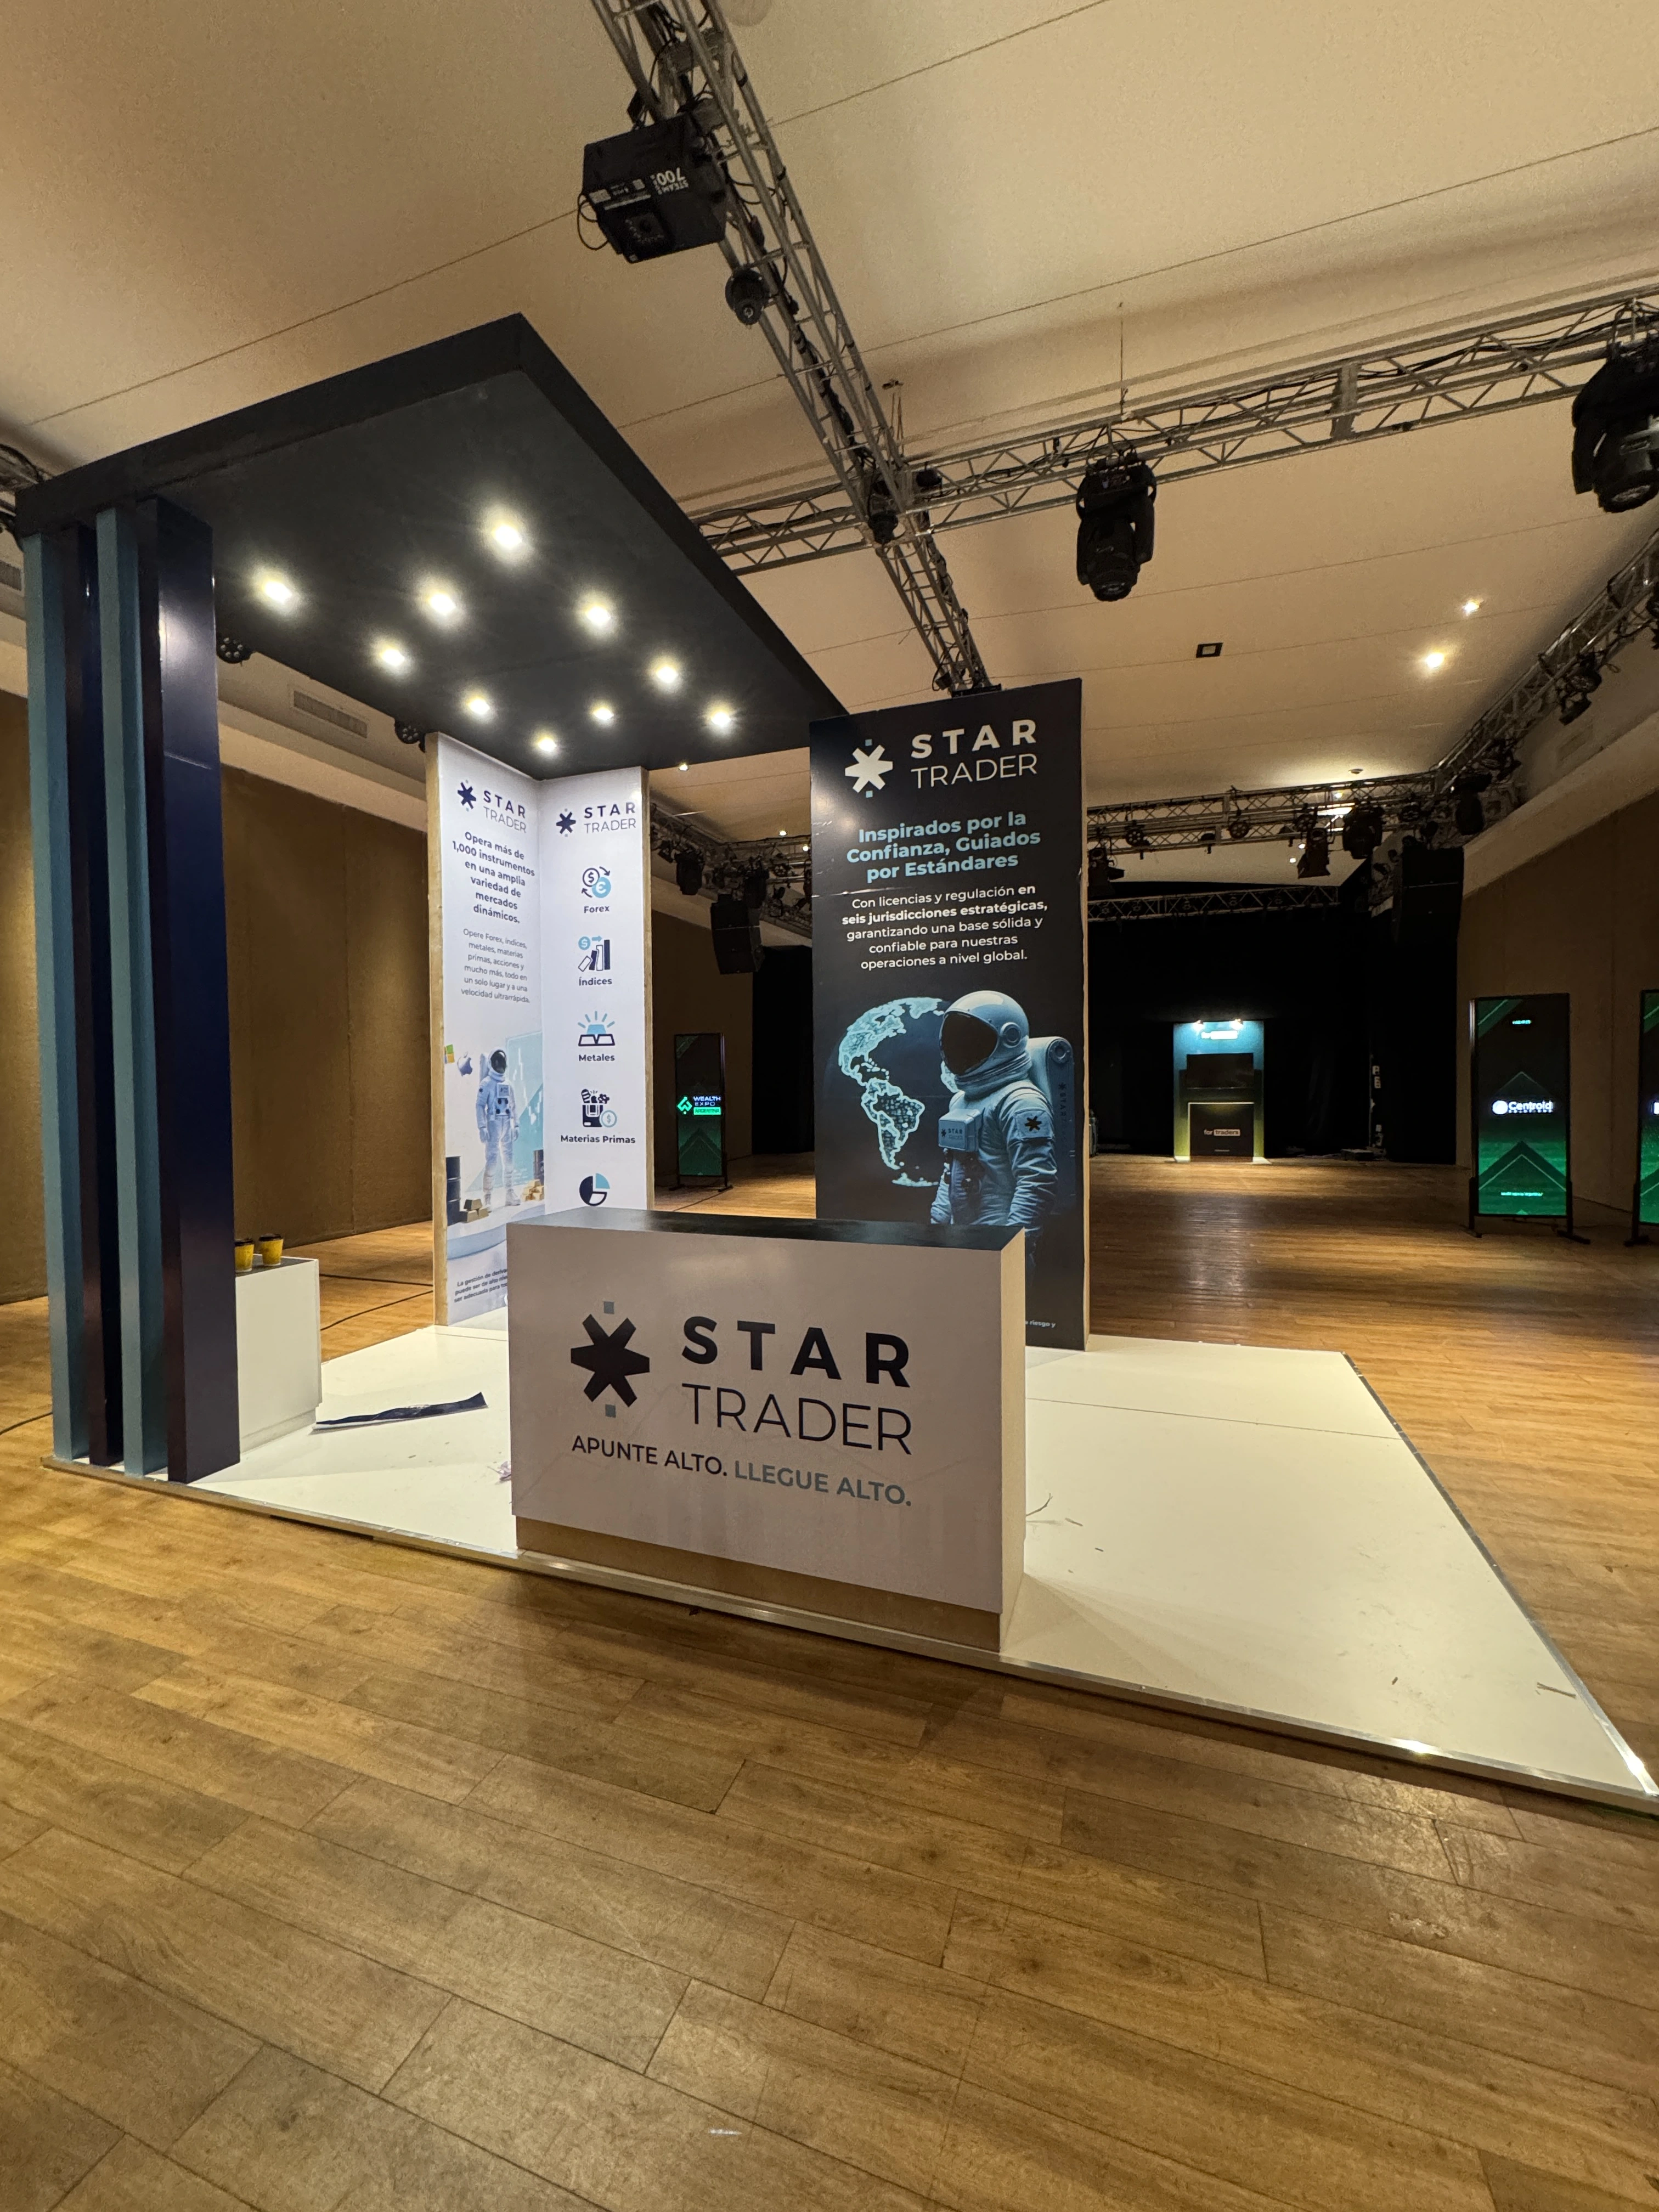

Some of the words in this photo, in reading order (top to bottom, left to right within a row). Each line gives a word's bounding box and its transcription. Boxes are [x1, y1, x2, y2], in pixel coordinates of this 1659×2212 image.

[657, 167, 686, 185] 700
[911, 719, 1036, 759] STAR
[911, 753, 1037, 789] TRADER
[483, 790, 525, 819] STAR
[584, 802, 635, 819] STAR
[483, 806, 526, 833] TRADER
[584, 818, 636, 834] TRADER
[859, 820, 961, 843] Inspirados
[967, 816, 1002, 834] por
[1008, 811, 1026, 826] la
[465, 832, 492, 848] Opera
[495, 844, 512, 855] más
[514, 850, 524, 860] de
[847, 843, 950, 863] Confianza,
[956, 832, 1041, 851] Guiados
[452, 840, 477, 856] 1,000
[479, 849, 535, 877] instrumentos
[867, 866, 900, 883] por
[905, 855, 1019, 877] Estándares
[465, 861, 476, 871] en
[479, 866, 495, 877] una
[498, 872, 525, 886] amplia
[470, 877, 509, 894] variedad
[511, 888, 521, 898] de
[852, 899, 876, 909] Con
[879, 894, 932, 906] licencias
[934, 894, 942, 904] y
[945, 886, 1014, 902] regulación
[1018, 885, 1036, 895] en
[476, 892, 518, 910] mercados
[473, 904, 520, 924] dinámicos.
[842, 913, 866, 925] seis
[867, 908, 957, 925] jurisdicciones
[960, 900, 1048, 914] estratégicas,
[463, 928, 484, 939] Opere
[486, 933, 504, 944] Forex,
[847, 924, 928, 942] garantizando
[932, 924, 955, 933] una
[959, 922, 989, 932] base
[992, 917, 1031, 929] sólida
[1034, 917, 1043, 928] y
[469, 943, 496, 953] metales,
[497, 948, 523, 958] materias
[869, 941, 927, 953] confiable
[930, 940, 958, 951] para
[962, 936, 1018, 947] nuestras
[468, 954, 492, 965] primas,
[493, 958, 520, 969] acciones
[861, 957, 936, 971] operaciones
[939, 956, 946, 964] a
[950, 952, 979, 964] nivel
[983, 949, 1028, 964] global.
[464, 965, 488, 974] mucho
[505, 971, 518, 980] todo
[579, 977, 612, 986] Índices
[461, 988, 493, 998] velocidad
[489, 979, 505, 990] lugar
[579, 1053, 615, 1062] Metales
[1508, 1101, 1553, 1110] Centroid
[561, 1135, 600, 1143] Materias
[602, 1135, 636, 1143] Primas
[681, 1316, 910, 1388] STAR
[681, 1383, 912, 1455] TRADER
[572, 1435, 658, 1465] APUNTE
[664, 1449, 727, 1476] ALTO.
[735, 1460, 828, 1493] LLEGUE
[837, 1477, 911, 1506] ALTO.
